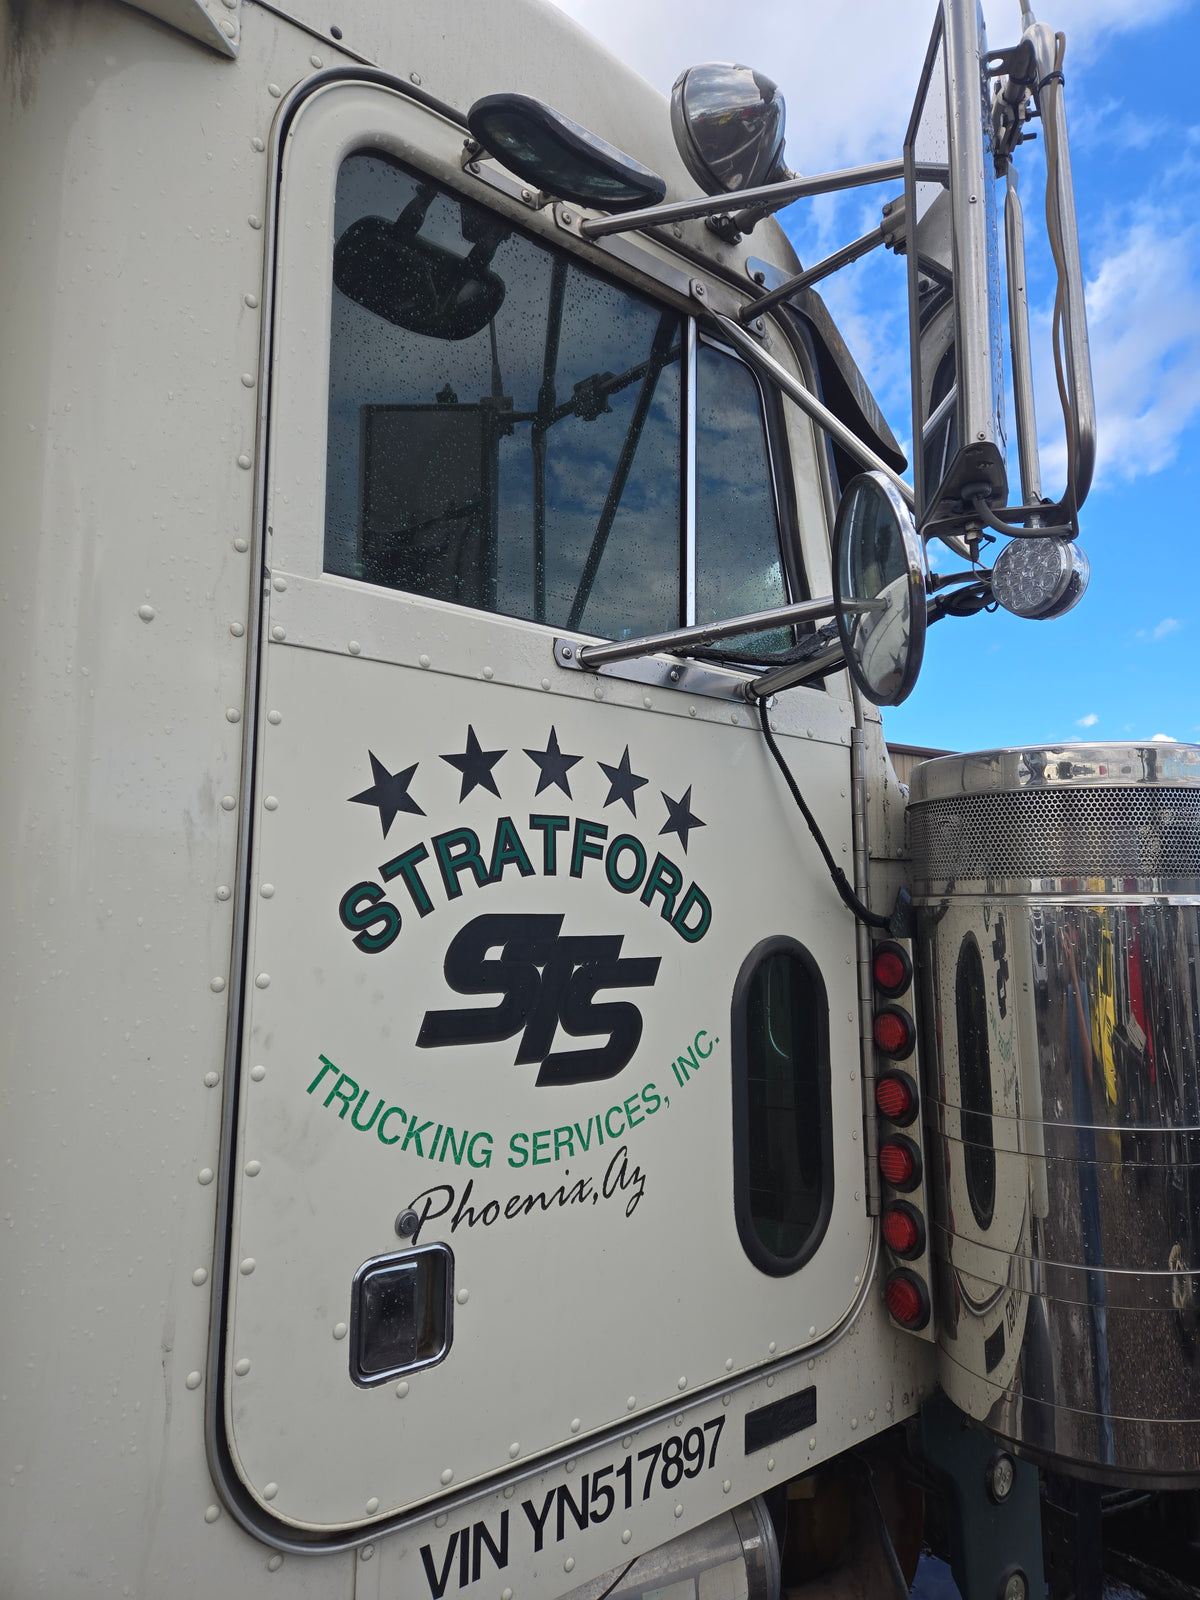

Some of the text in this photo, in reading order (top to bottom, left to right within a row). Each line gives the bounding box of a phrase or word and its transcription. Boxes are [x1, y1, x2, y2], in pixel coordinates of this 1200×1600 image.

[339, 813, 712, 954] STRATFORD
[415, 913, 661, 1087] STS
[306, 1030, 720, 1169] TRUCKING SERVICES, INC.
[419, 1510, 509, 1600] VIN
[521, 1415, 726, 1553] YN517897
